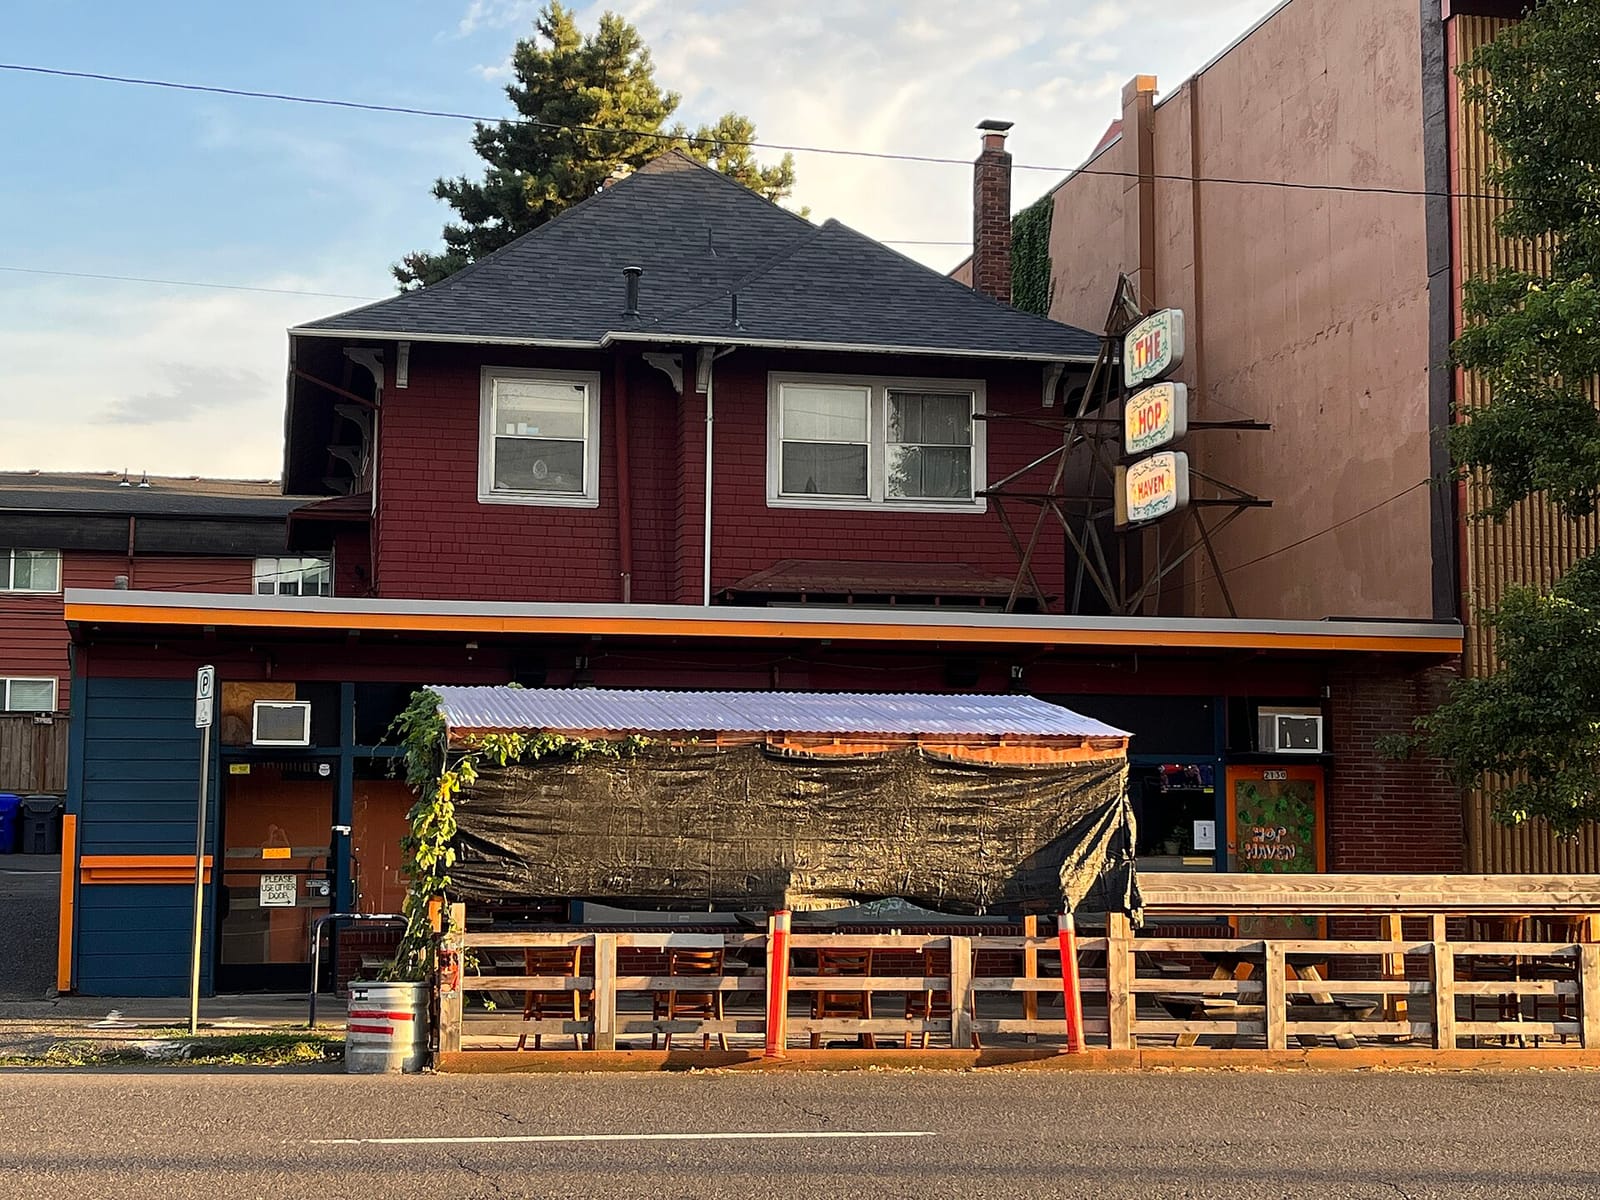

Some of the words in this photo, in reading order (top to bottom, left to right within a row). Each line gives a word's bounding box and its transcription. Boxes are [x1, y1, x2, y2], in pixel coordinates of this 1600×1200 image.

[1136, 330, 1161, 368] THE
[1139, 401, 1161, 435] HOP
[1138, 473, 1165, 501] HAVEN
[1252, 826, 1287, 842] HOP
[1245, 843, 1296, 860] HAVEN
[264, 875, 293, 883] PLEASE
[262, 884, 274, 892] USE
[275, 883, 296, 892] OTHER
[268, 892, 289, 900] DOOR
